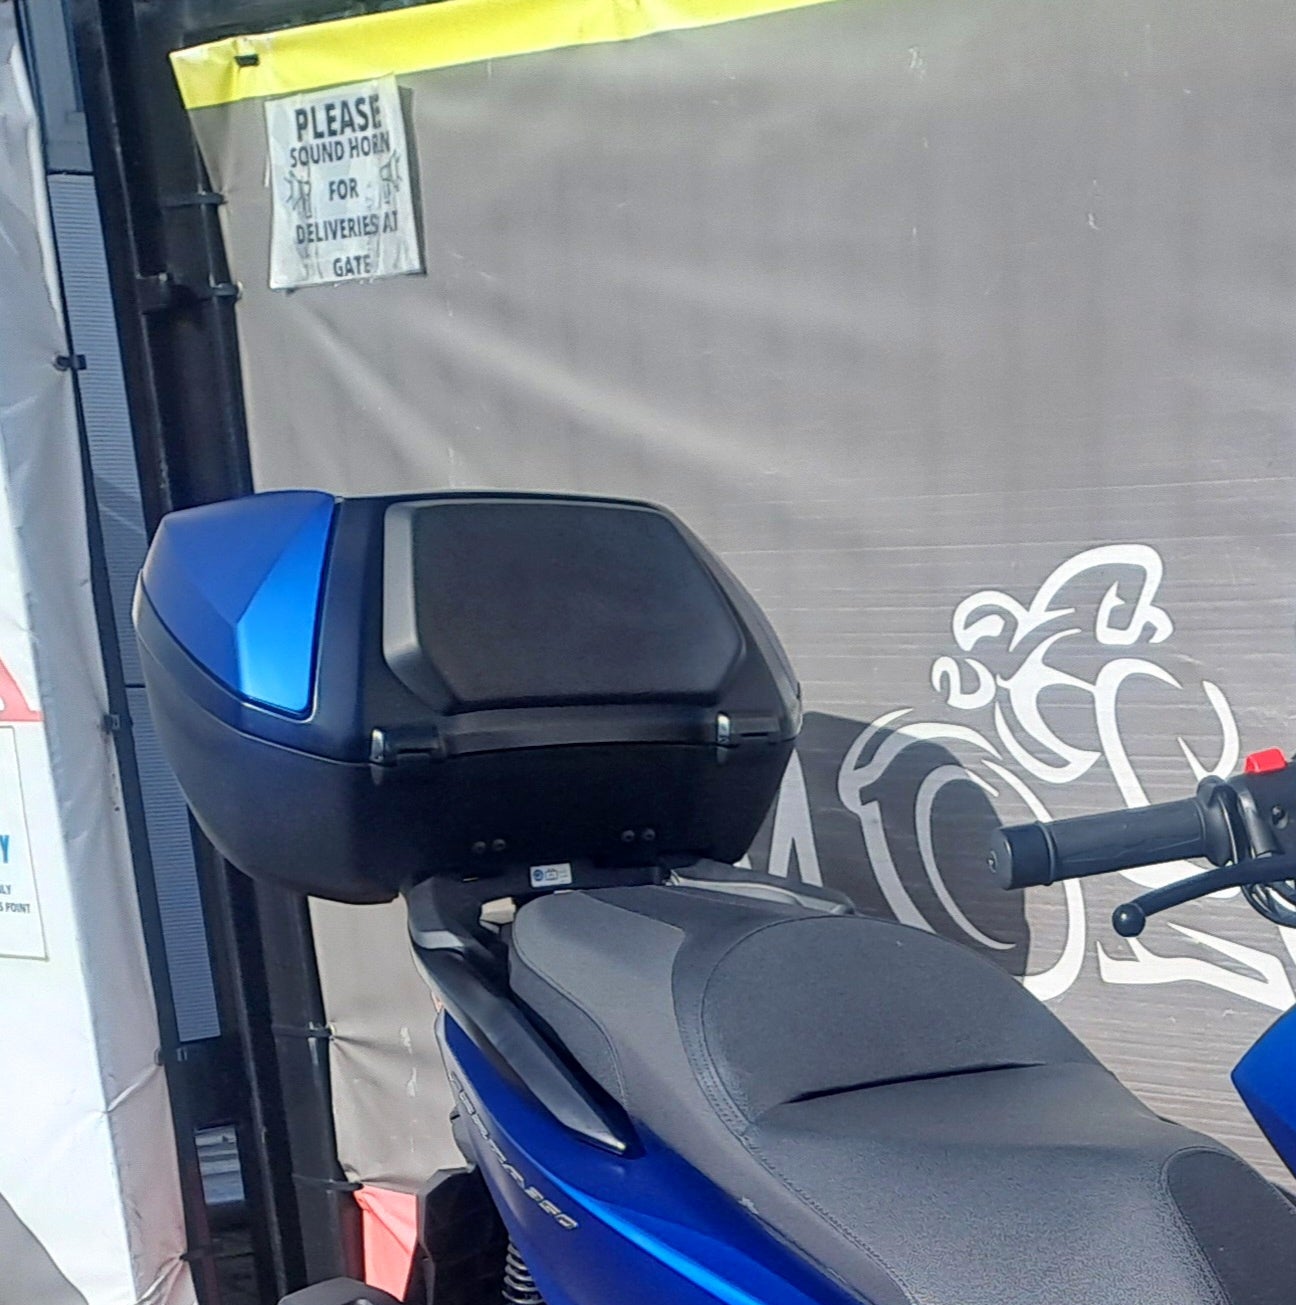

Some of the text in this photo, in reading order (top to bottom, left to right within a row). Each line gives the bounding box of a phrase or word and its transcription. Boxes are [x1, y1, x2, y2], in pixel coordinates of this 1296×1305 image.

[294, 93, 382, 142] PLEASE
[289, 131, 390, 168] SOUND HORN
[328, 177, 359, 201] FOR
[296, 210, 398, 245] DELIVERIES AT
[333, 253, 371, 277] GATE
